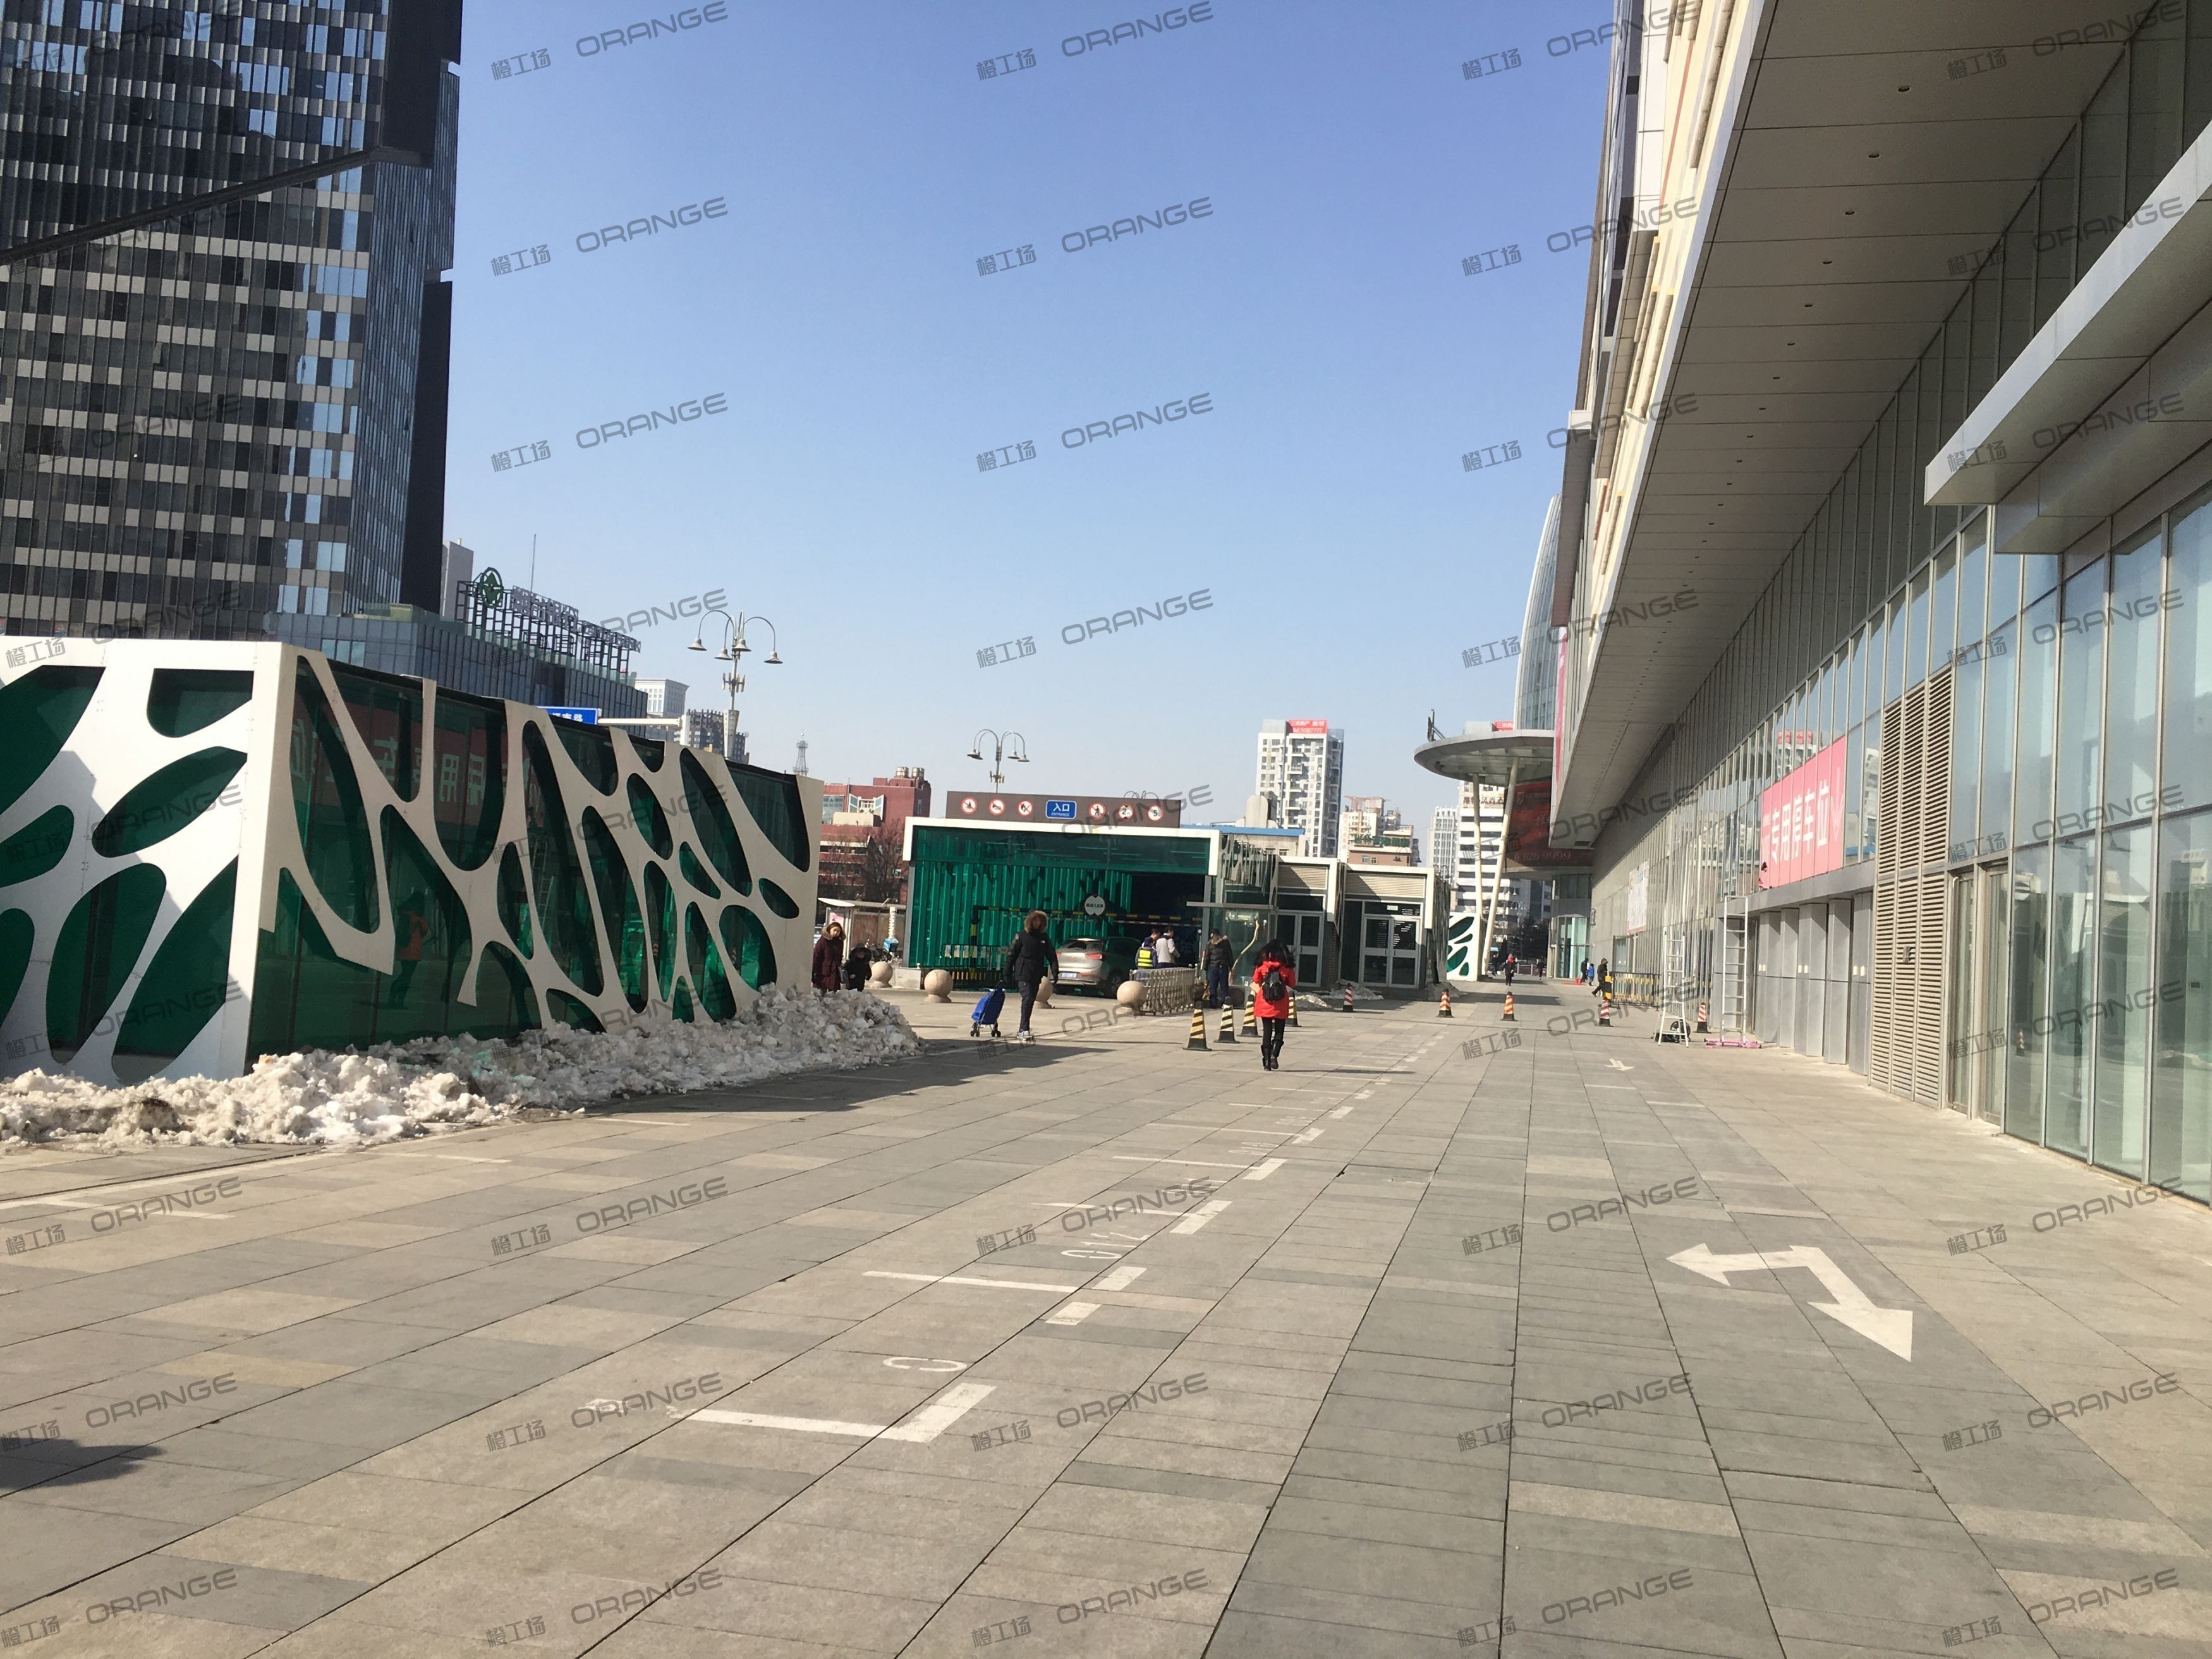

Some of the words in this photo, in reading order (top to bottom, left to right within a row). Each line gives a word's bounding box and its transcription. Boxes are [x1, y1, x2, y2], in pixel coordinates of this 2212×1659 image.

[1052, 803, 1070, 812] 入口
[1771, 779, 1829, 865] 专用停车位
[1060, 1232, 1150, 1260] 012
